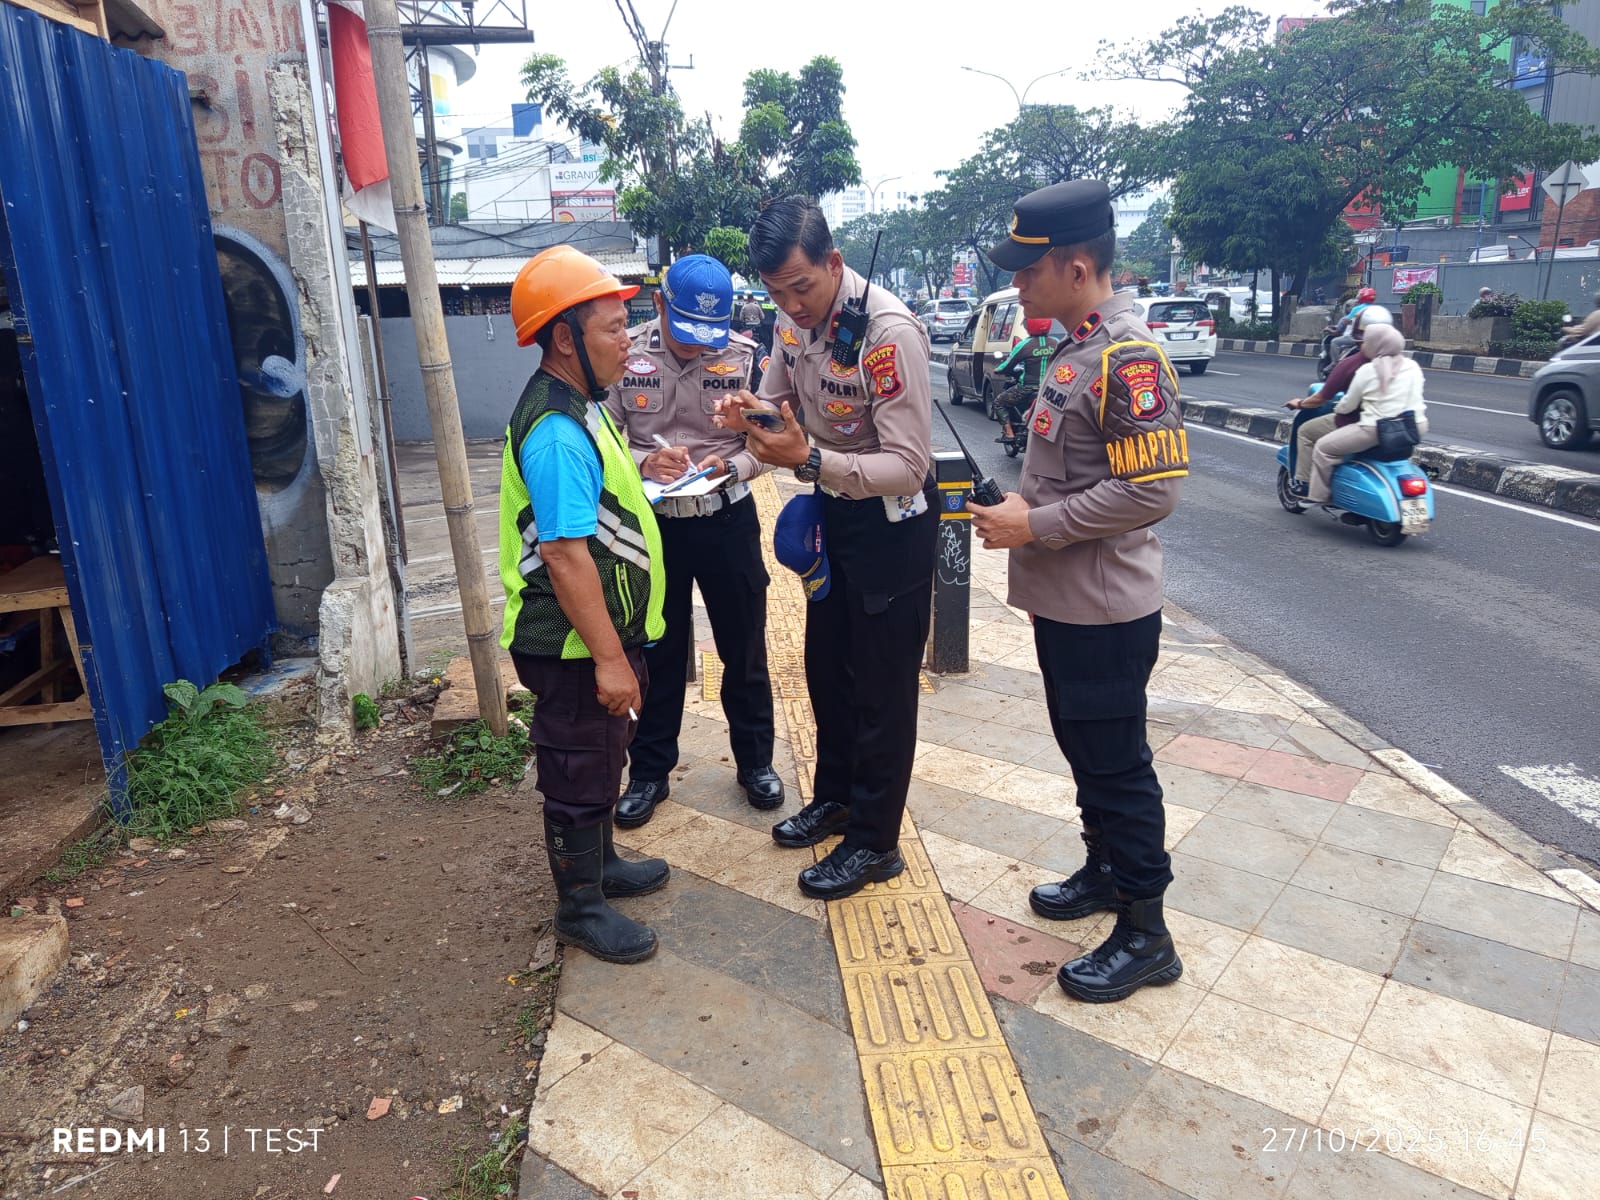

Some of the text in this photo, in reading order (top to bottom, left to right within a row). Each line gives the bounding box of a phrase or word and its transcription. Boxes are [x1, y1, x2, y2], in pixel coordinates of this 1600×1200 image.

[1032, 347, 1055, 357] Grab
[703, 378, 740, 390] POLRI
[820, 378, 858, 397] POLRI
[1043, 386, 1067, 408] POLRI
[1106, 429, 1179, 476] PAMAPTA
